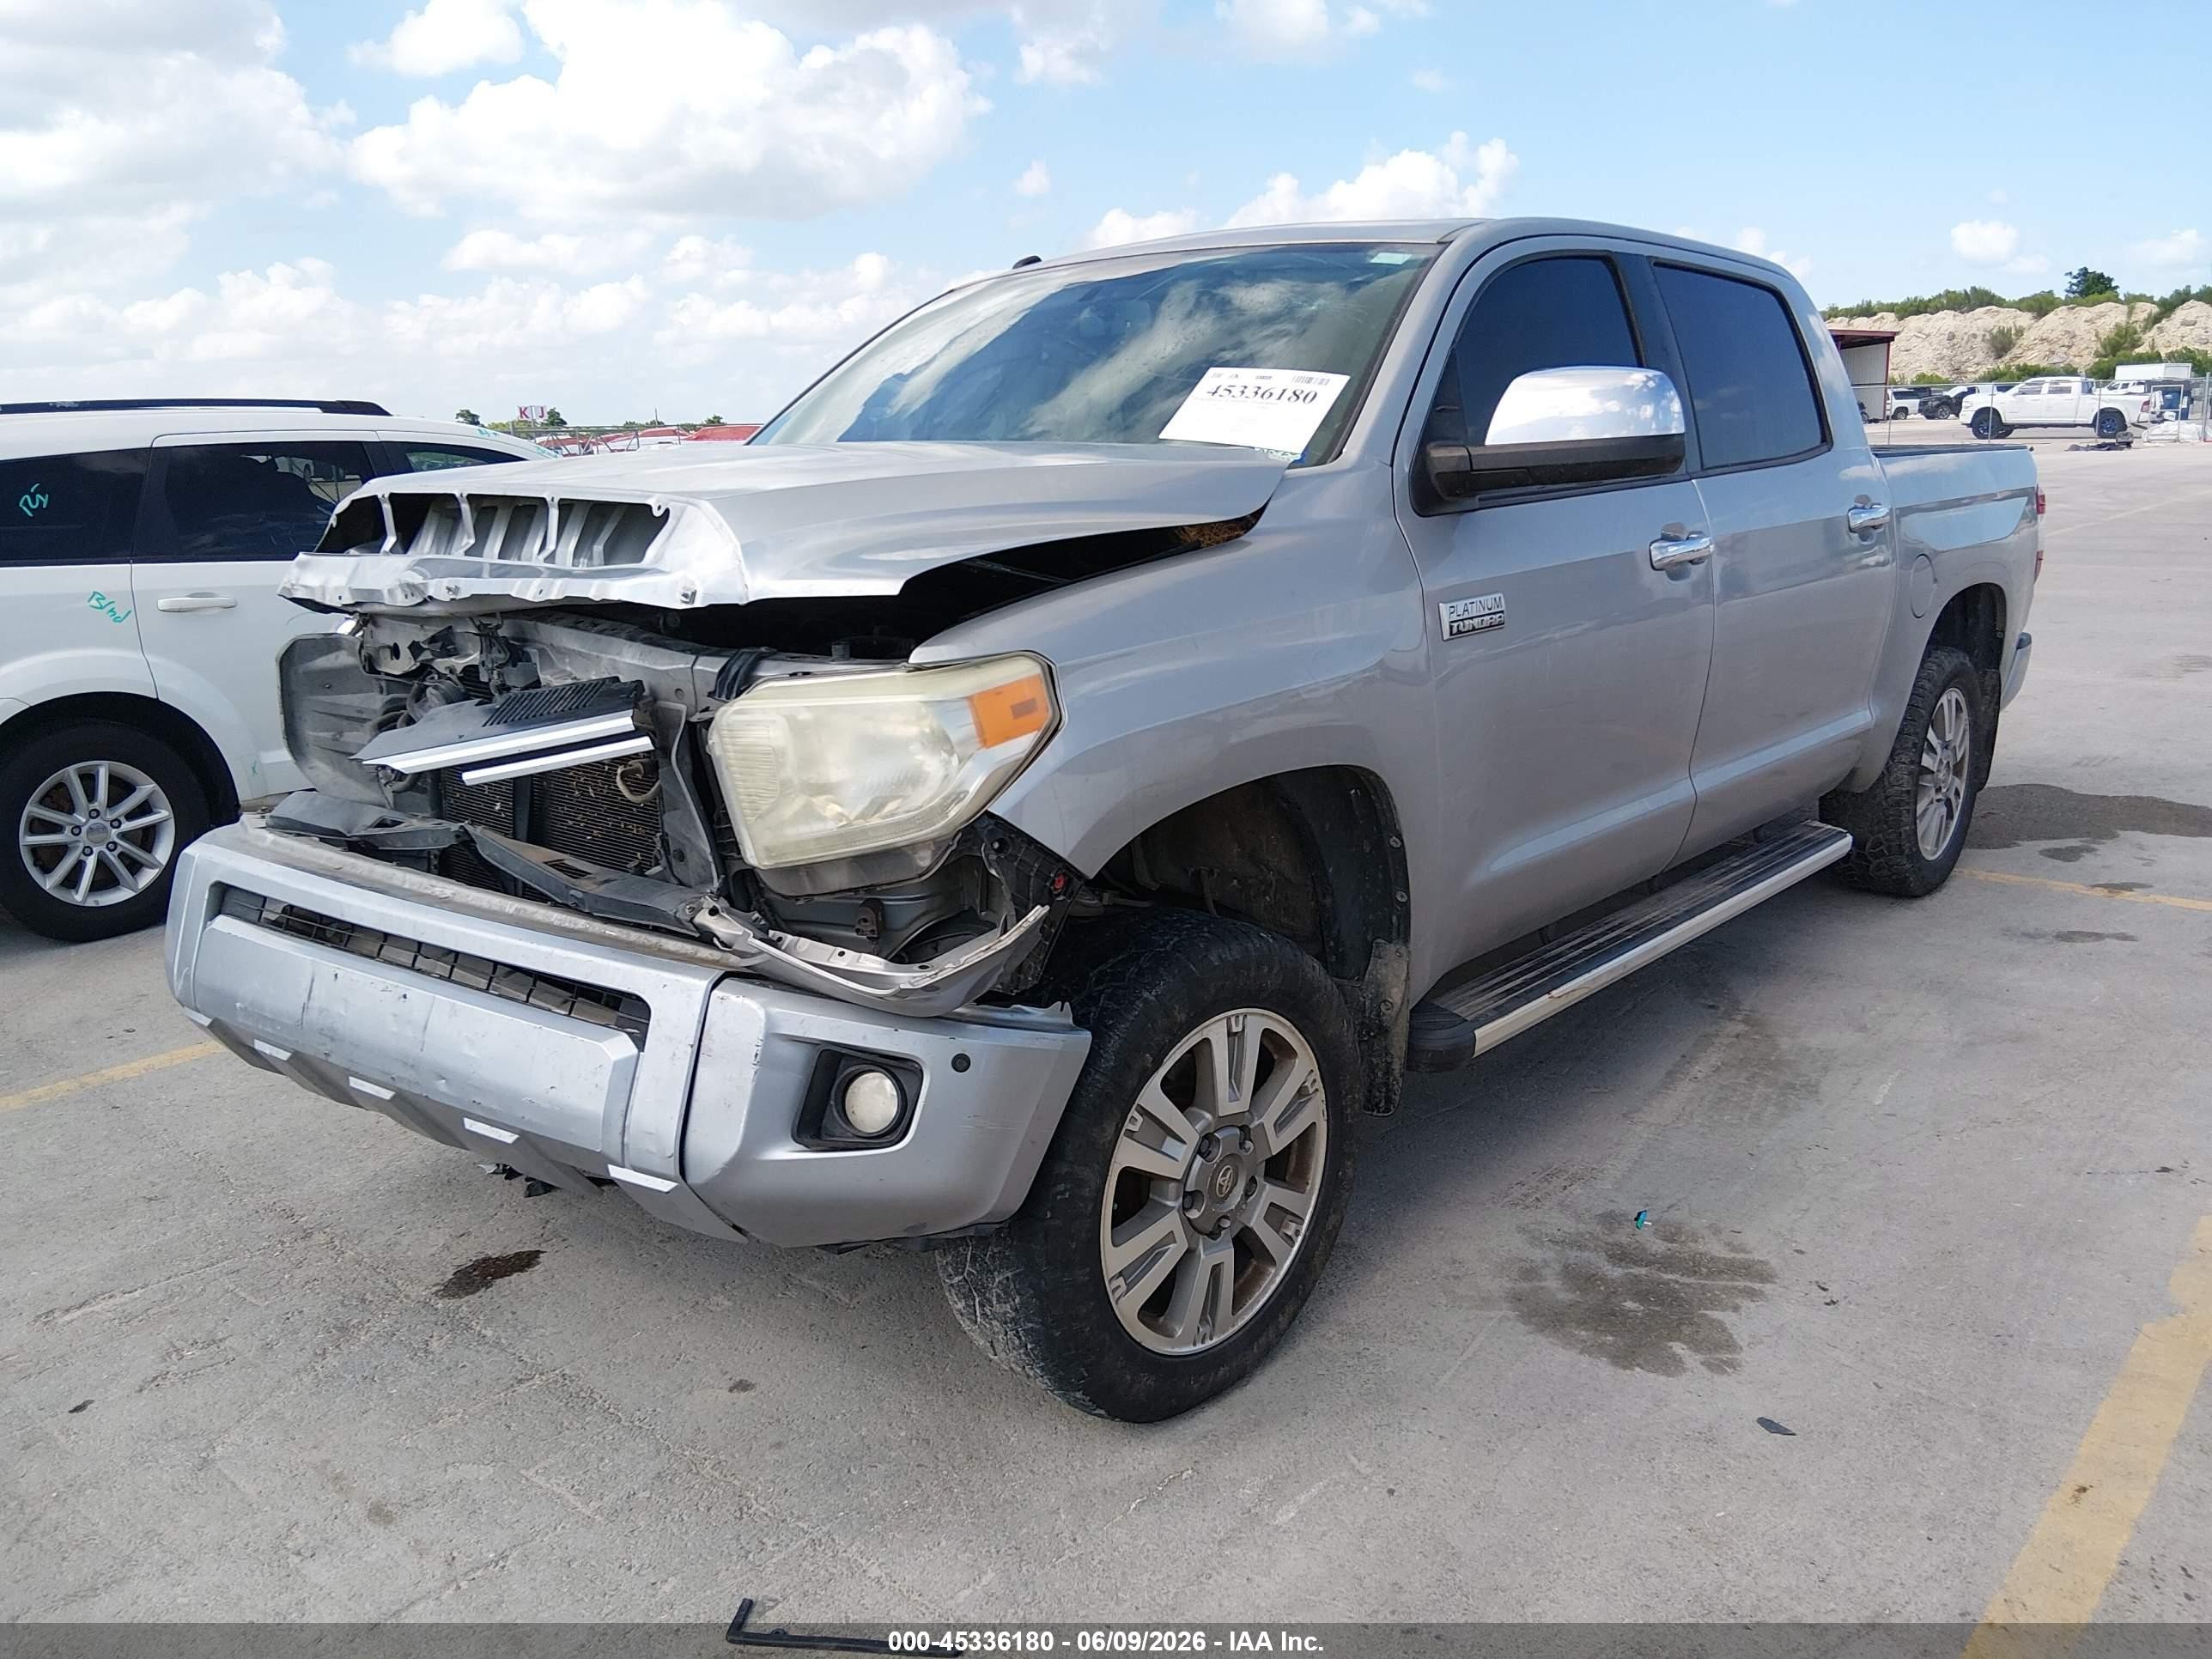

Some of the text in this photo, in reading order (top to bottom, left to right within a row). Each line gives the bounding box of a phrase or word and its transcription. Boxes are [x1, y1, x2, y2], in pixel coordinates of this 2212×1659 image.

[1206, 384, 1319, 404] 45336180
[519, 406, 530, 419] K
[1449, 596, 1503, 618] PLATINUM
[1449, 613, 1504, 635] TUNDRA
